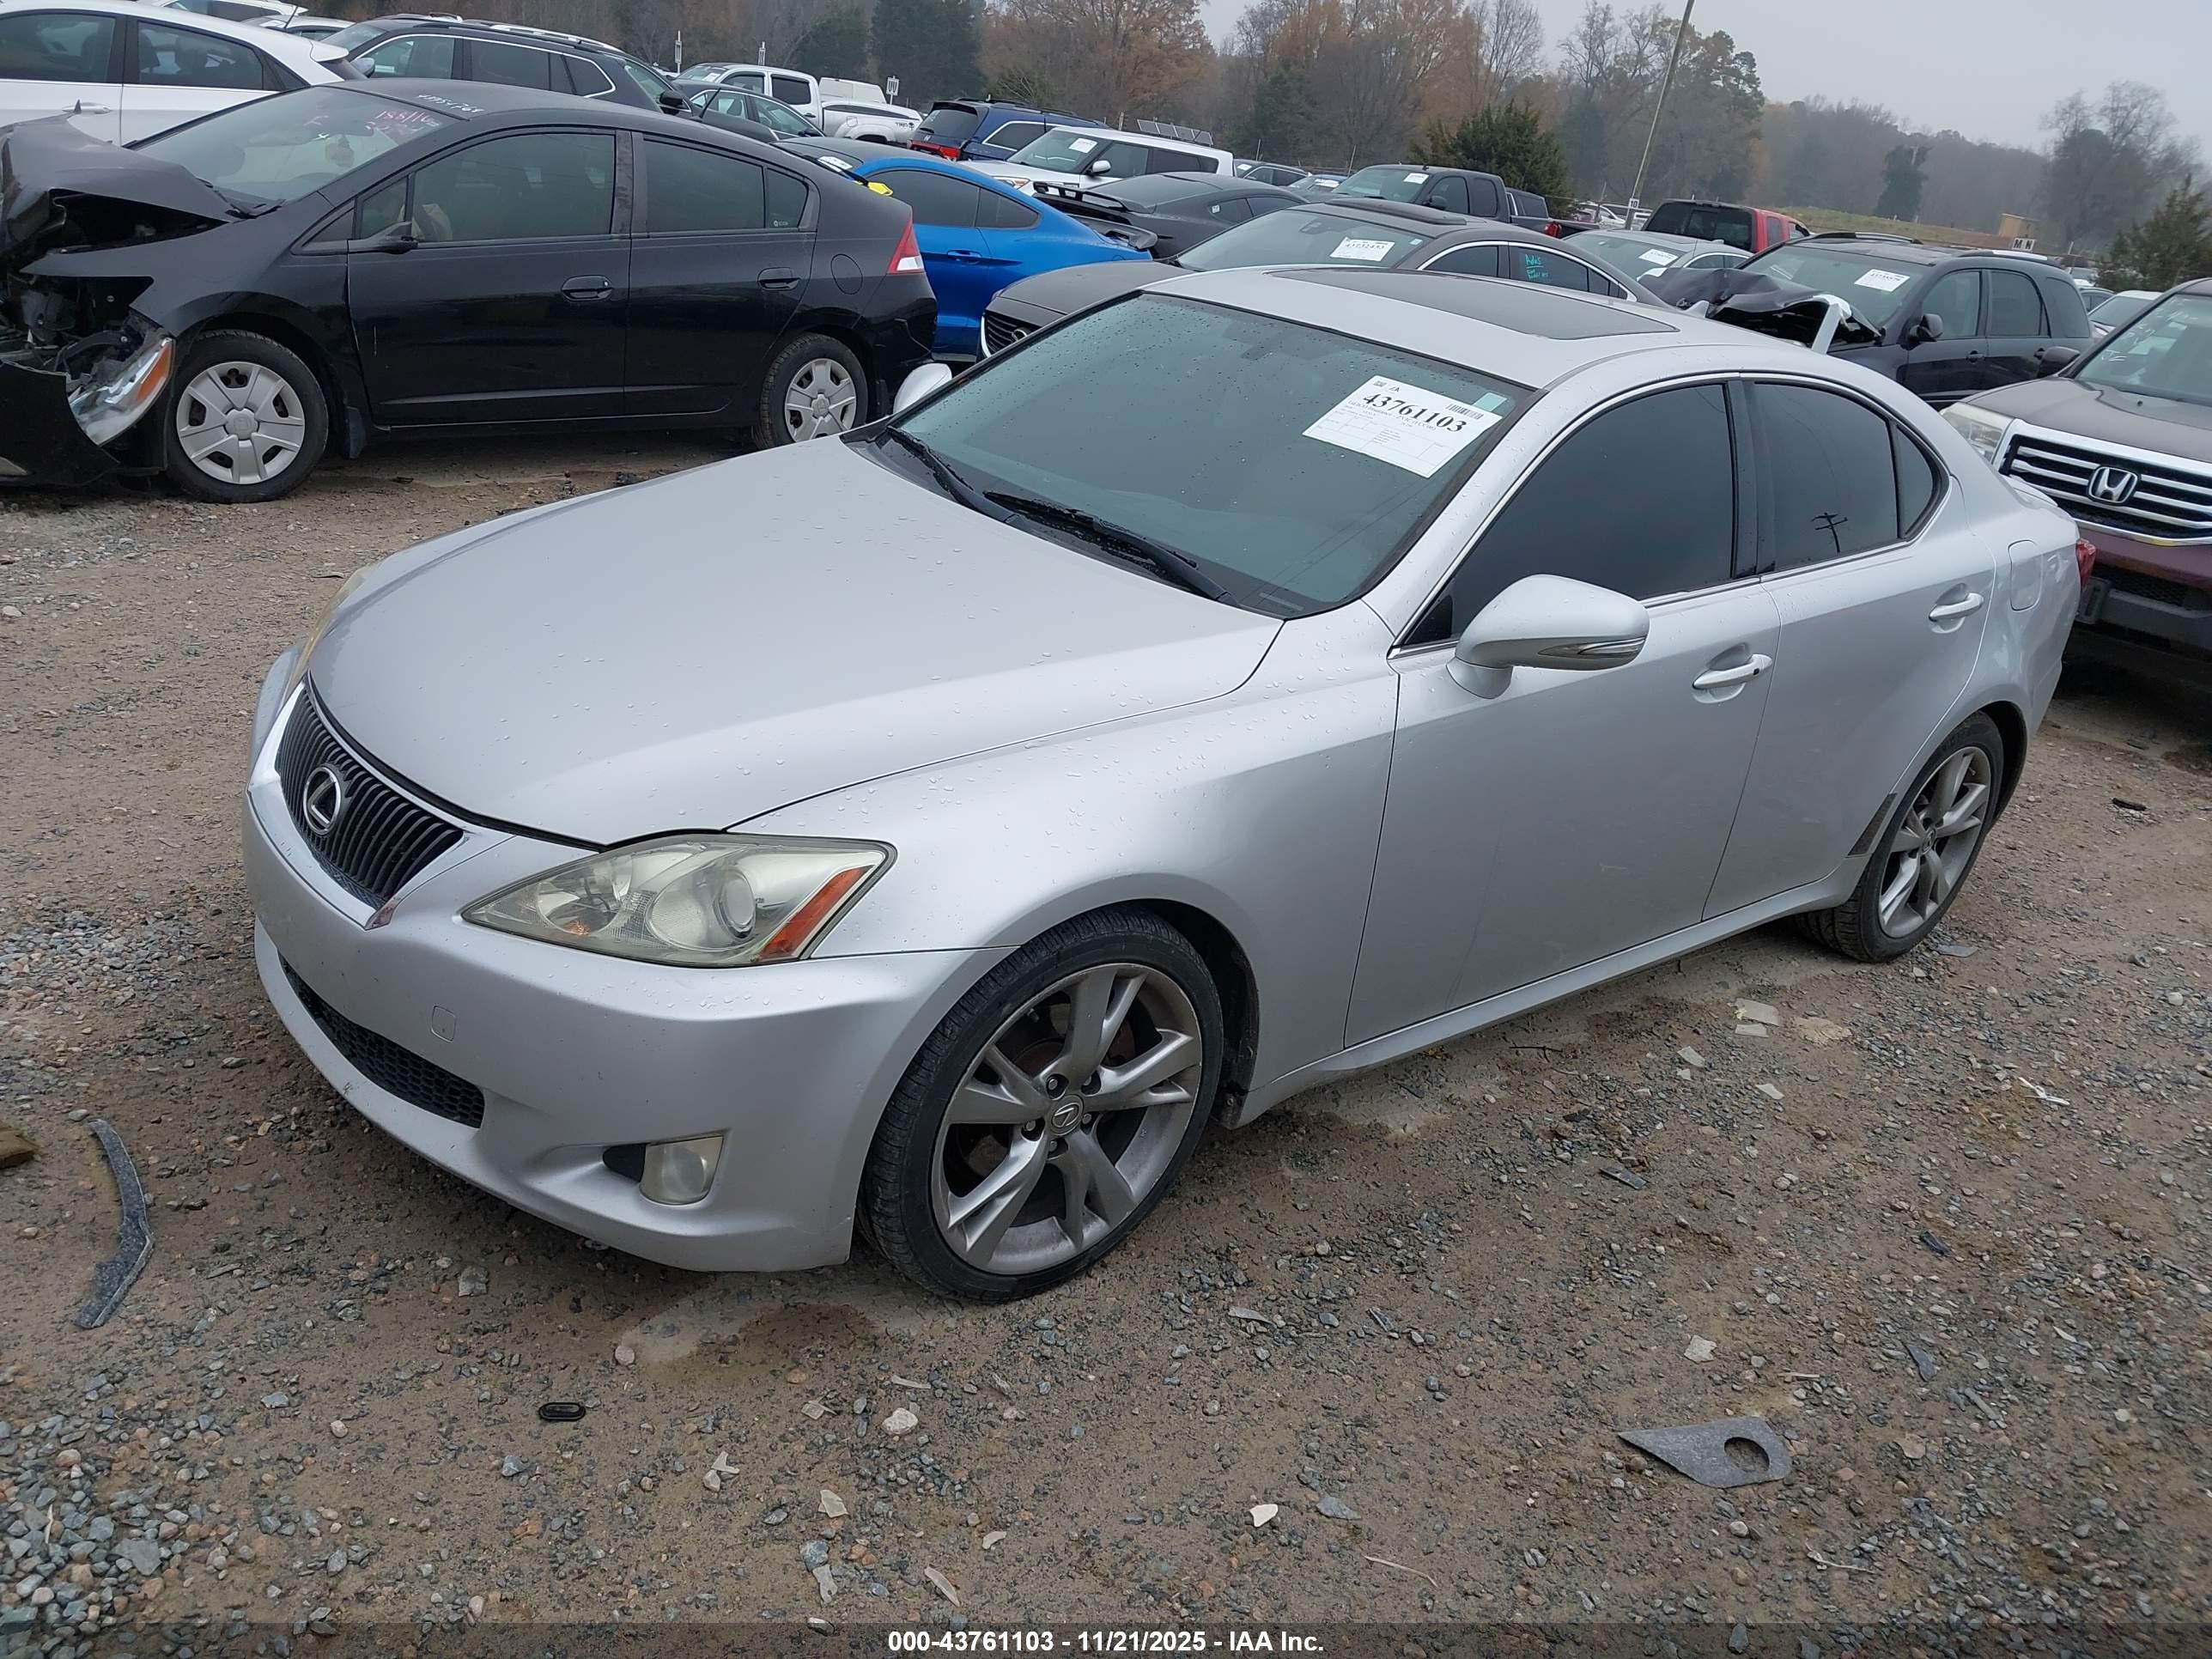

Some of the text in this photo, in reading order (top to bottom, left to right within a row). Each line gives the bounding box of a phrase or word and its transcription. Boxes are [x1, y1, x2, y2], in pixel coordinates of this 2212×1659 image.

[2014, 239, 2034, 250] M N
[1363, 393, 1468, 433] 43761103
